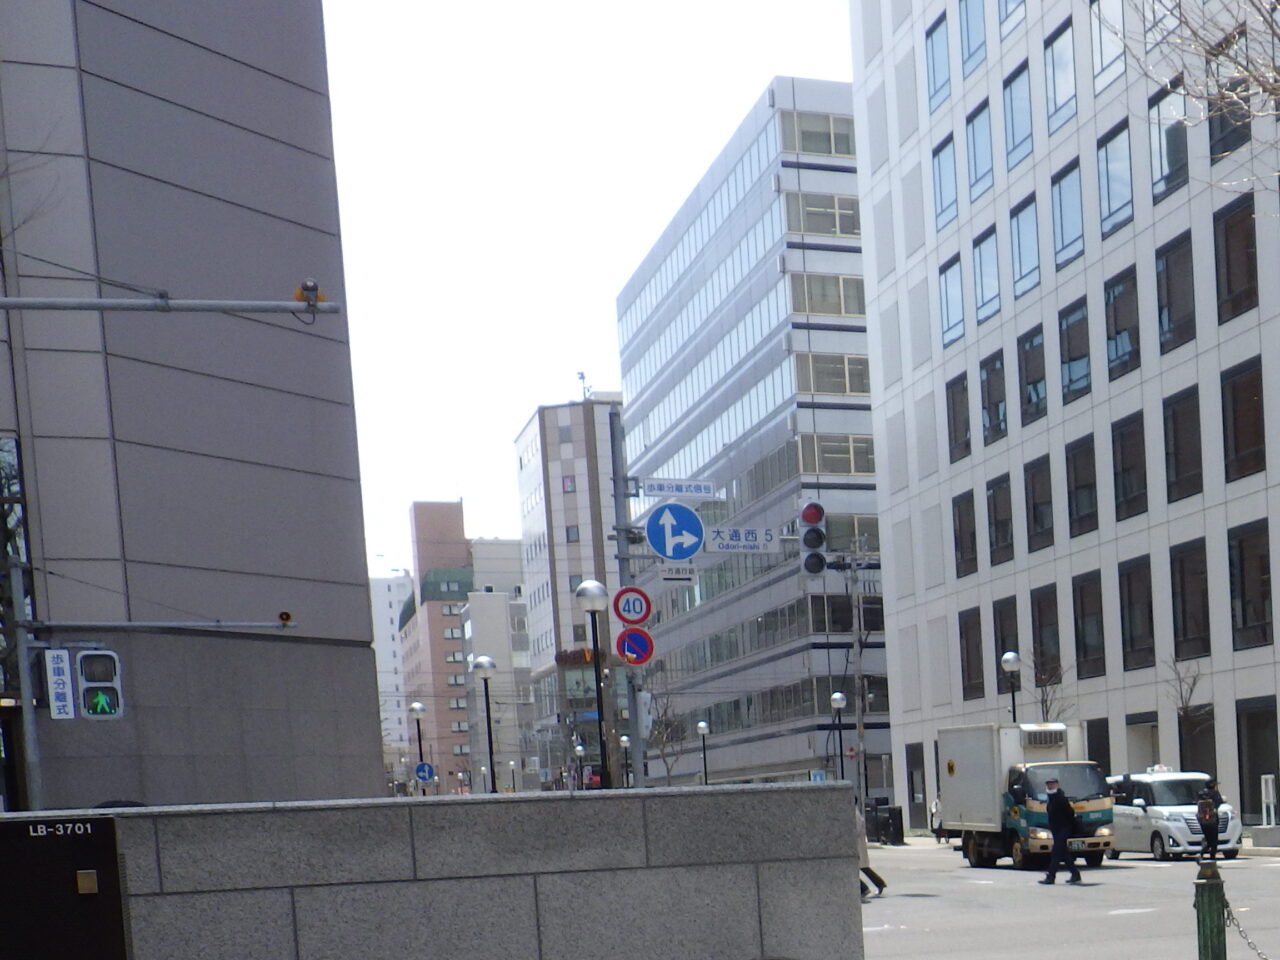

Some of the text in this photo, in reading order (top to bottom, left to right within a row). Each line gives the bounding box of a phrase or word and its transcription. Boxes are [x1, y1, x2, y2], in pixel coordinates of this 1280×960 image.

[711, 528, 773, 542] 大通西 5
[718, 542, 760, 550] Odori-nishi
[622, 597, 643, 614] 40
[51, 654, 69, 715] 歩車分離式
[29, 823, 92, 836] LB-3701
